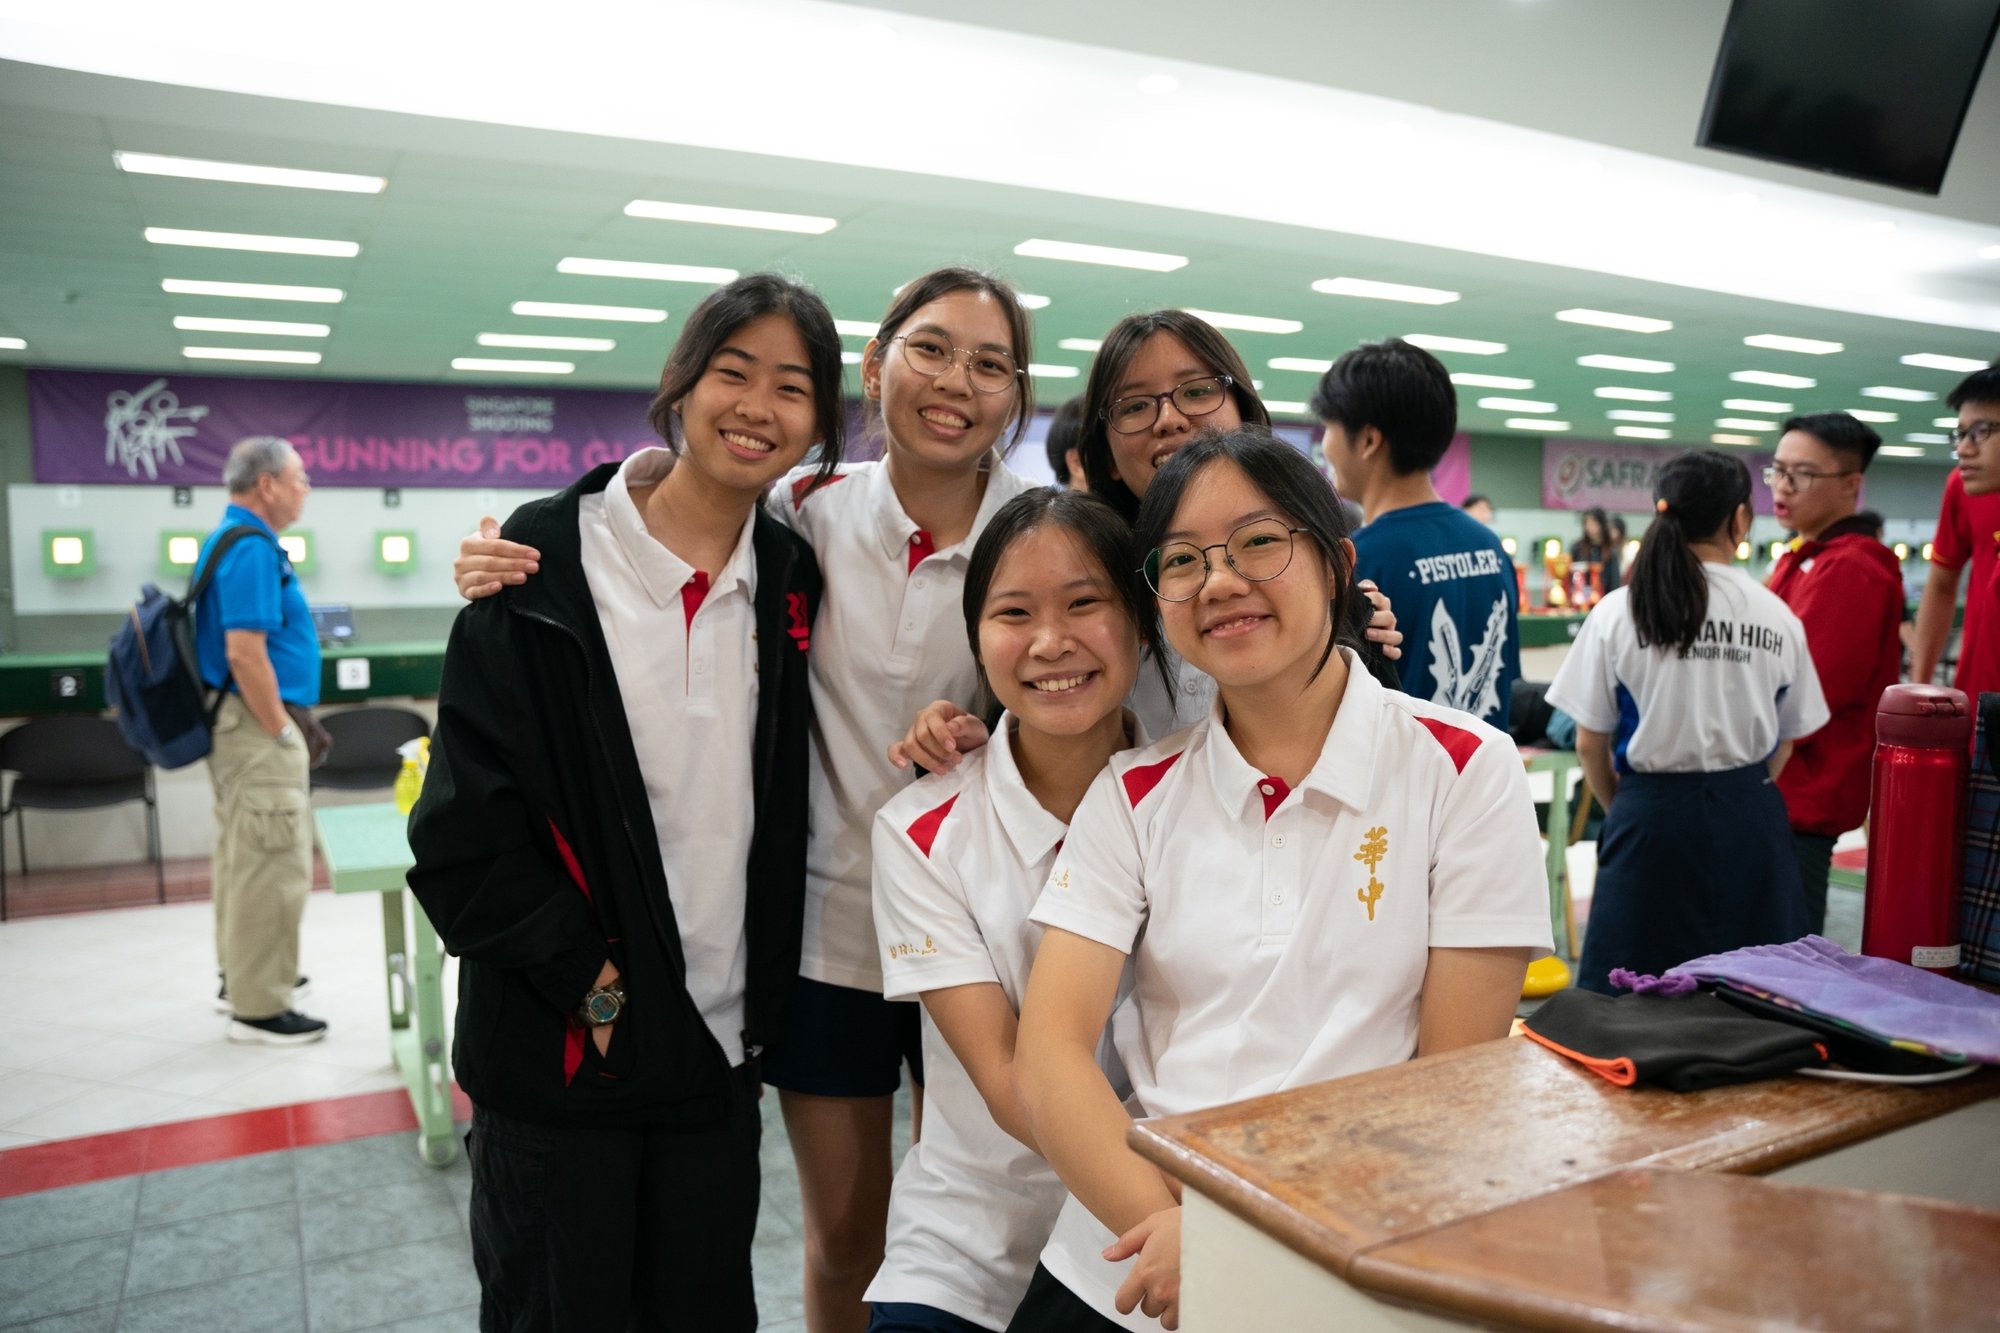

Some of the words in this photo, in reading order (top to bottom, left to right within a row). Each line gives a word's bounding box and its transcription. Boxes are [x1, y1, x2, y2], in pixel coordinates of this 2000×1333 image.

[494, 437, 572, 474] FOR
[1723, 647, 1750, 664] HIGH
[1740, 623, 1783, 657] HIGH
